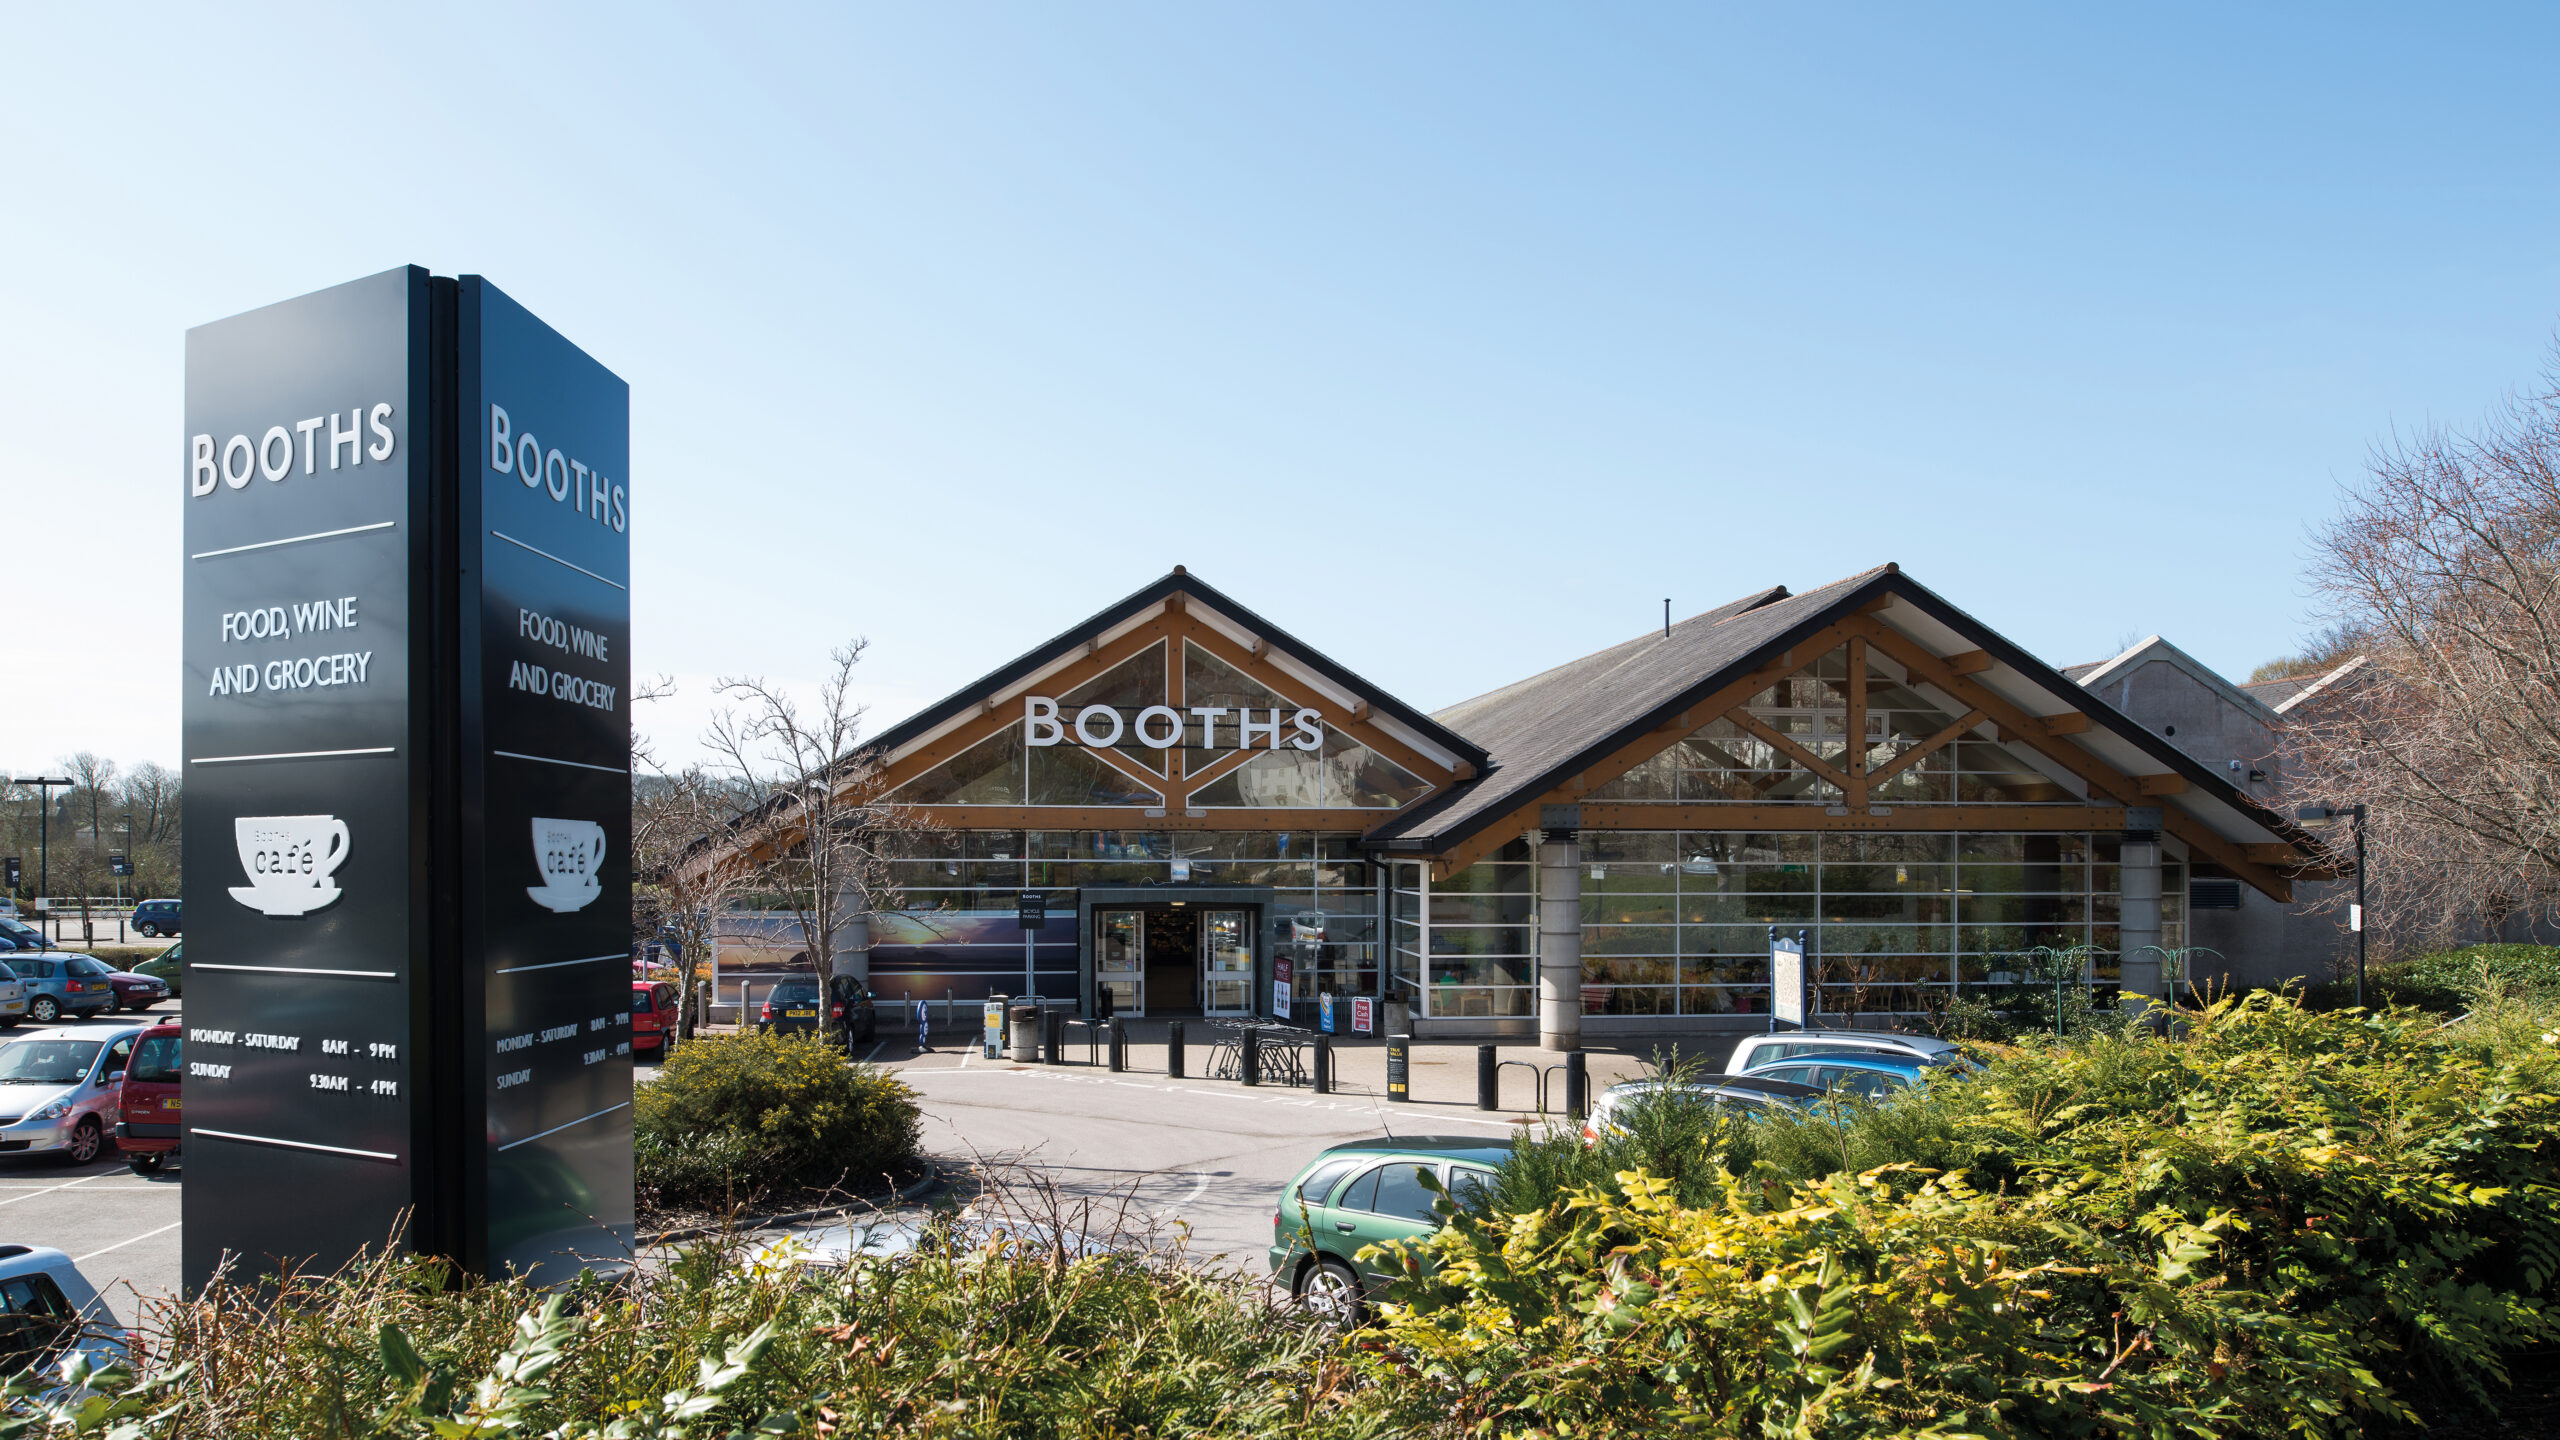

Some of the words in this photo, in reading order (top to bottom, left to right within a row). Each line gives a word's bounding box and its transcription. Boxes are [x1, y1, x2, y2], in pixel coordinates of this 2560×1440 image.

[192, 402, 397, 497] BOOTHS
[490, 403, 626, 533] BOOTHS
[222, 606, 291, 642] FOOD,
[293, 596, 358, 633] WINE
[519, 608, 569, 654] FOOD,
[569, 624, 608, 662] WINE
[209, 663, 260, 696] AND
[265, 651, 372, 691] GROCERY
[509, 660, 549, 695] AND
[551, 671, 616, 712] GROCERY
[1024, 696, 1325, 751] BOOTHS
[255, 839, 313, 875] café
[547, 841, 585, 875] café
[190, 1028, 235, 1045] MONDAY
[244, 1033, 300, 1051] SATURDAY
[322, 1039, 348, 1055] 8AM
[496, 1032, 534, 1054] MONDAY
[540, 1023, 578, 1044] SATURDAY
[590, 1016, 606, 1032] 8AM
[190, 1061, 232, 1079] SUNDAY
[496, 1068, 531, 1090] SUNDAY
[1263, 1096, 1395, 1115] TAXIS
